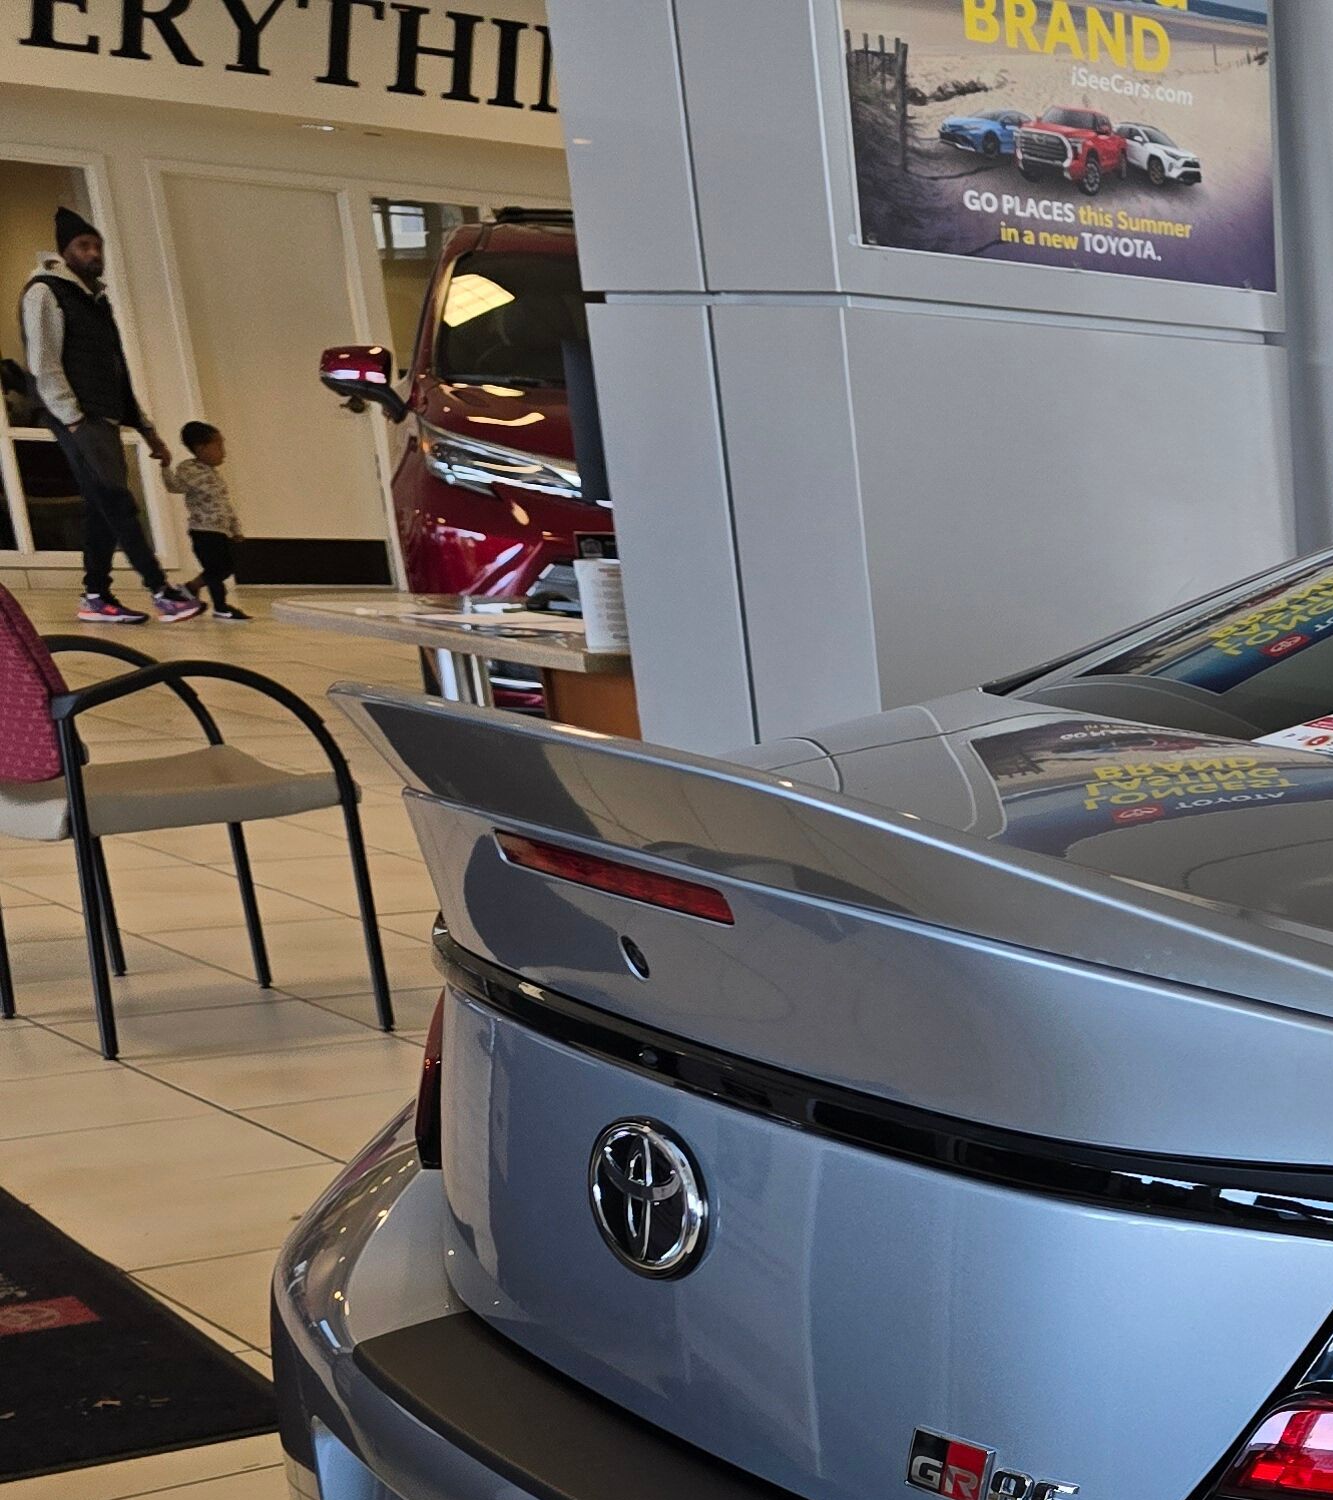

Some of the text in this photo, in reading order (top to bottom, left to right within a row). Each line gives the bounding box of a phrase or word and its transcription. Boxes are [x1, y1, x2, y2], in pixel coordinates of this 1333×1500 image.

[963, 0, 1171, 73] BRAND
[1071, 66, 1193, 106] iSeeCars.com
[963, 190, 1192, 239] GO PLACES this Summer
[1000, 221, 1162, 262] in a new TOYOTA.
